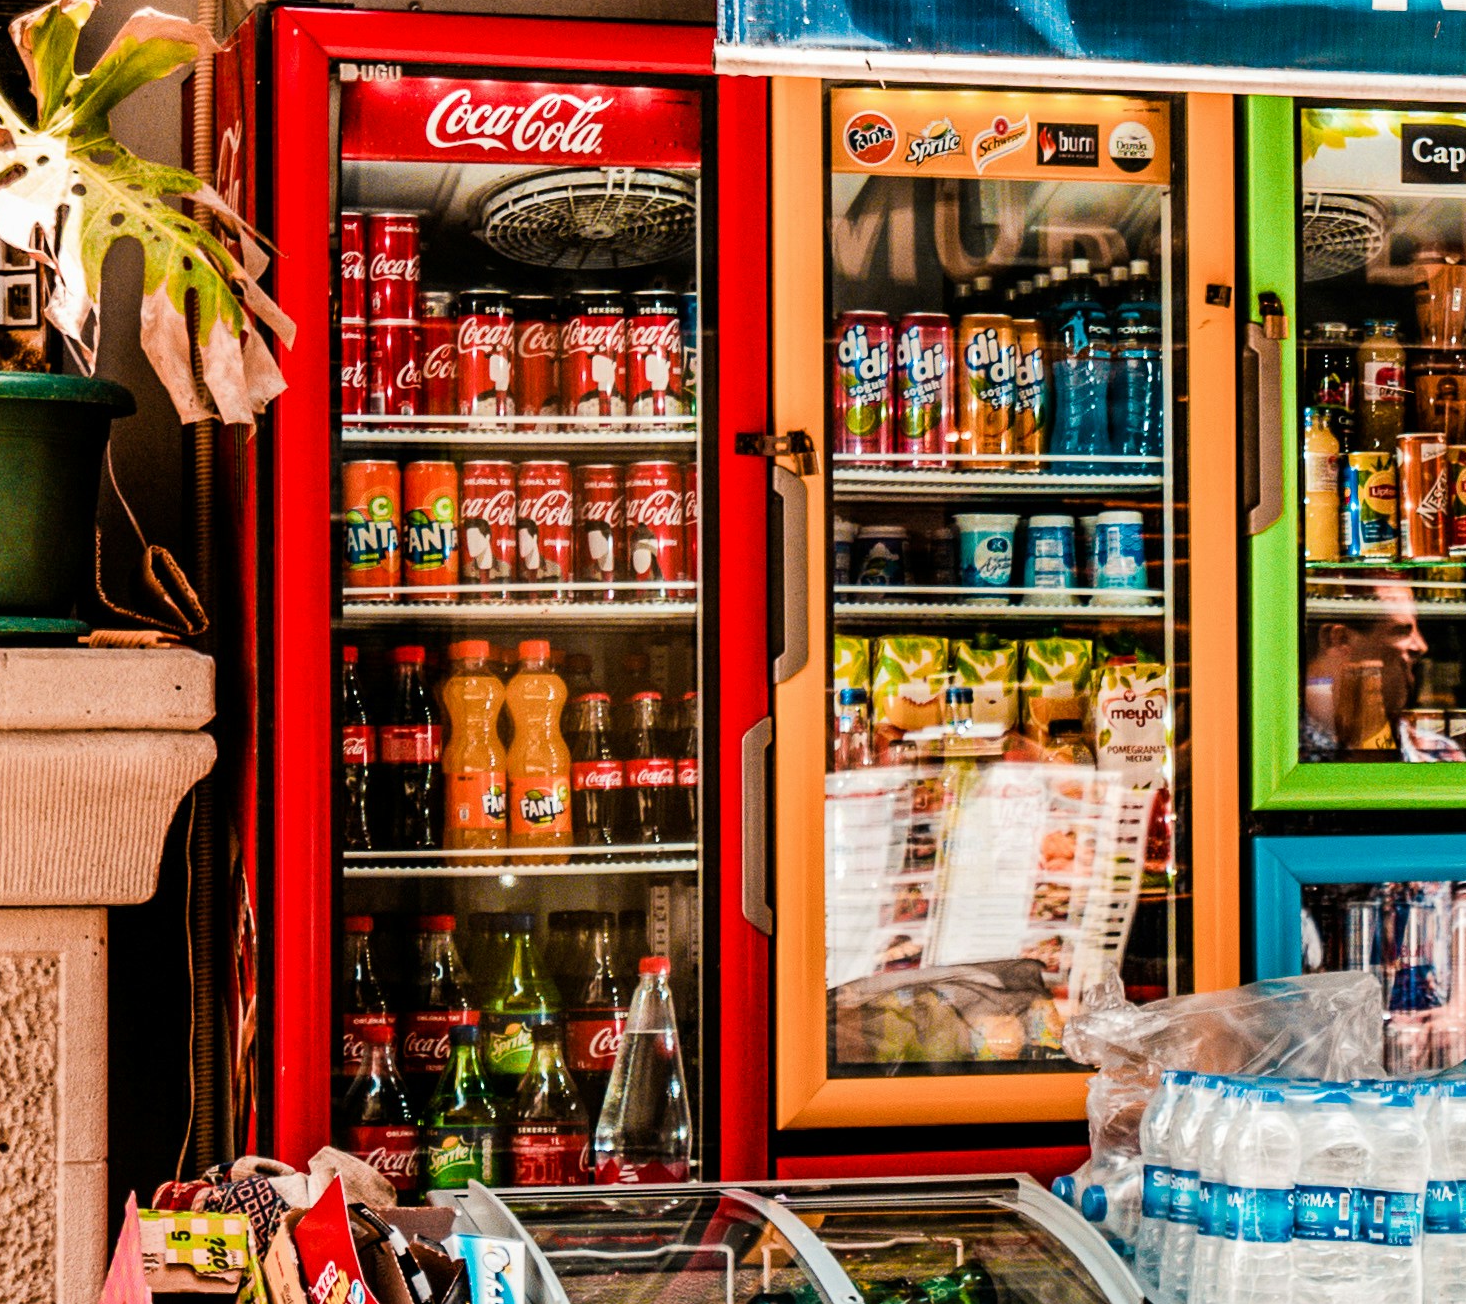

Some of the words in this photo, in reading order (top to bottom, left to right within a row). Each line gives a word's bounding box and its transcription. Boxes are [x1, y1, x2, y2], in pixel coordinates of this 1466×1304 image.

[426, 88, 613, 154] Coca-Cola
[847, 127, 894, 153] Fanta
[906, 133, 961, 163] Sprite
[1059, 132, 1095, 151] burn
[1370, 486, 1396, 497] Lipto
[345, 521, 399, 553] ANTA
[407, 521, 458, 553] ANTA
[1106, 745, 1166, 755] POMEGRANAT
